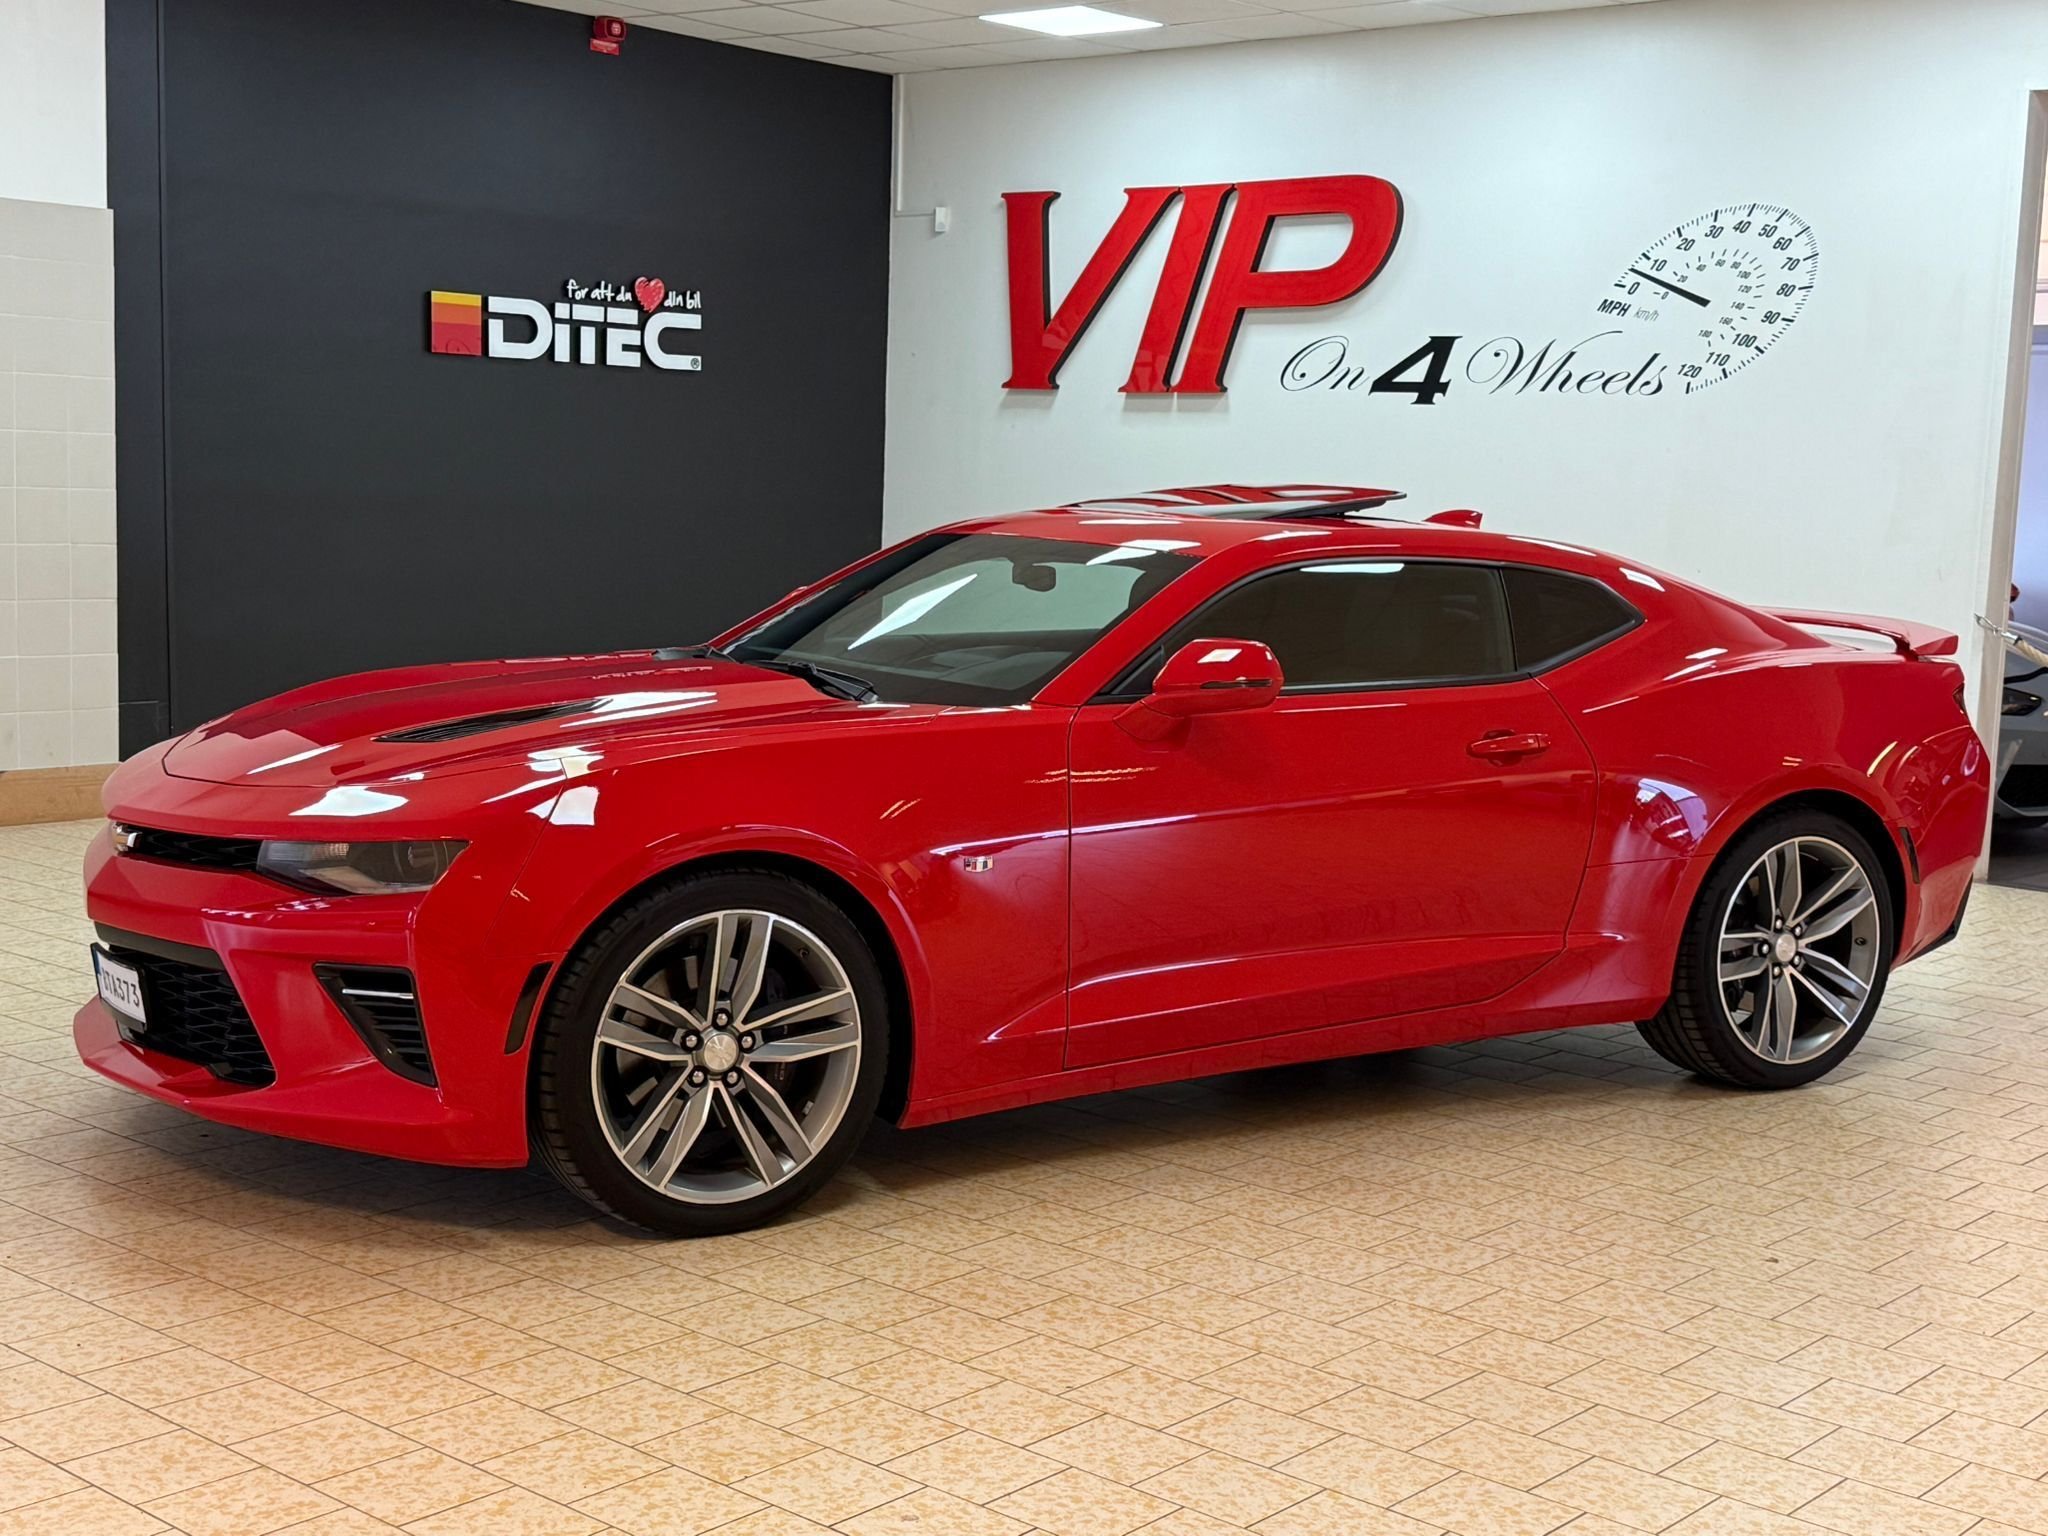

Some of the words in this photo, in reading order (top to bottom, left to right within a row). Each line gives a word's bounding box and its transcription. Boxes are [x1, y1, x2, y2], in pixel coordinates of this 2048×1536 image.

[1704, 225, 1724, 239] 30
[1732, 220, 1752, 233] 40
[1758, 224, 1778, 238] 50
[1676, 238, 1695, 251] 20
[1772, 237, 1792, 251] 60
[1650, 258, 1667, 272] 10
[1780, 257, 1800, 271] 70
[1000, 174, 1404, 393] VIP
[1677, 275, 1688, 283] 20
[590, 281, 615, 302] att
[616, 286, 632, 302] du
[1627, 281, 1640, 295] 0
[1737, 285, 1752, 293] 120
[1776, 284, 1796, 297] 80
[1661, 291, 1669, 300] 0
[1597, 299, 1631, 317] MPH
[1633, 307, 1659, 322] km/h
[1761, 311, 1781, 324] 90
[1732, 334, 1757, 348] 100
[1705, 352, 1731, 366] 110
[1279, 335, 1370, 393] On
[1368, 335, 1464, 405] 4
[1465, 330, 1667, 396] Wheels
[1677, 363, 1702, 379] 120
